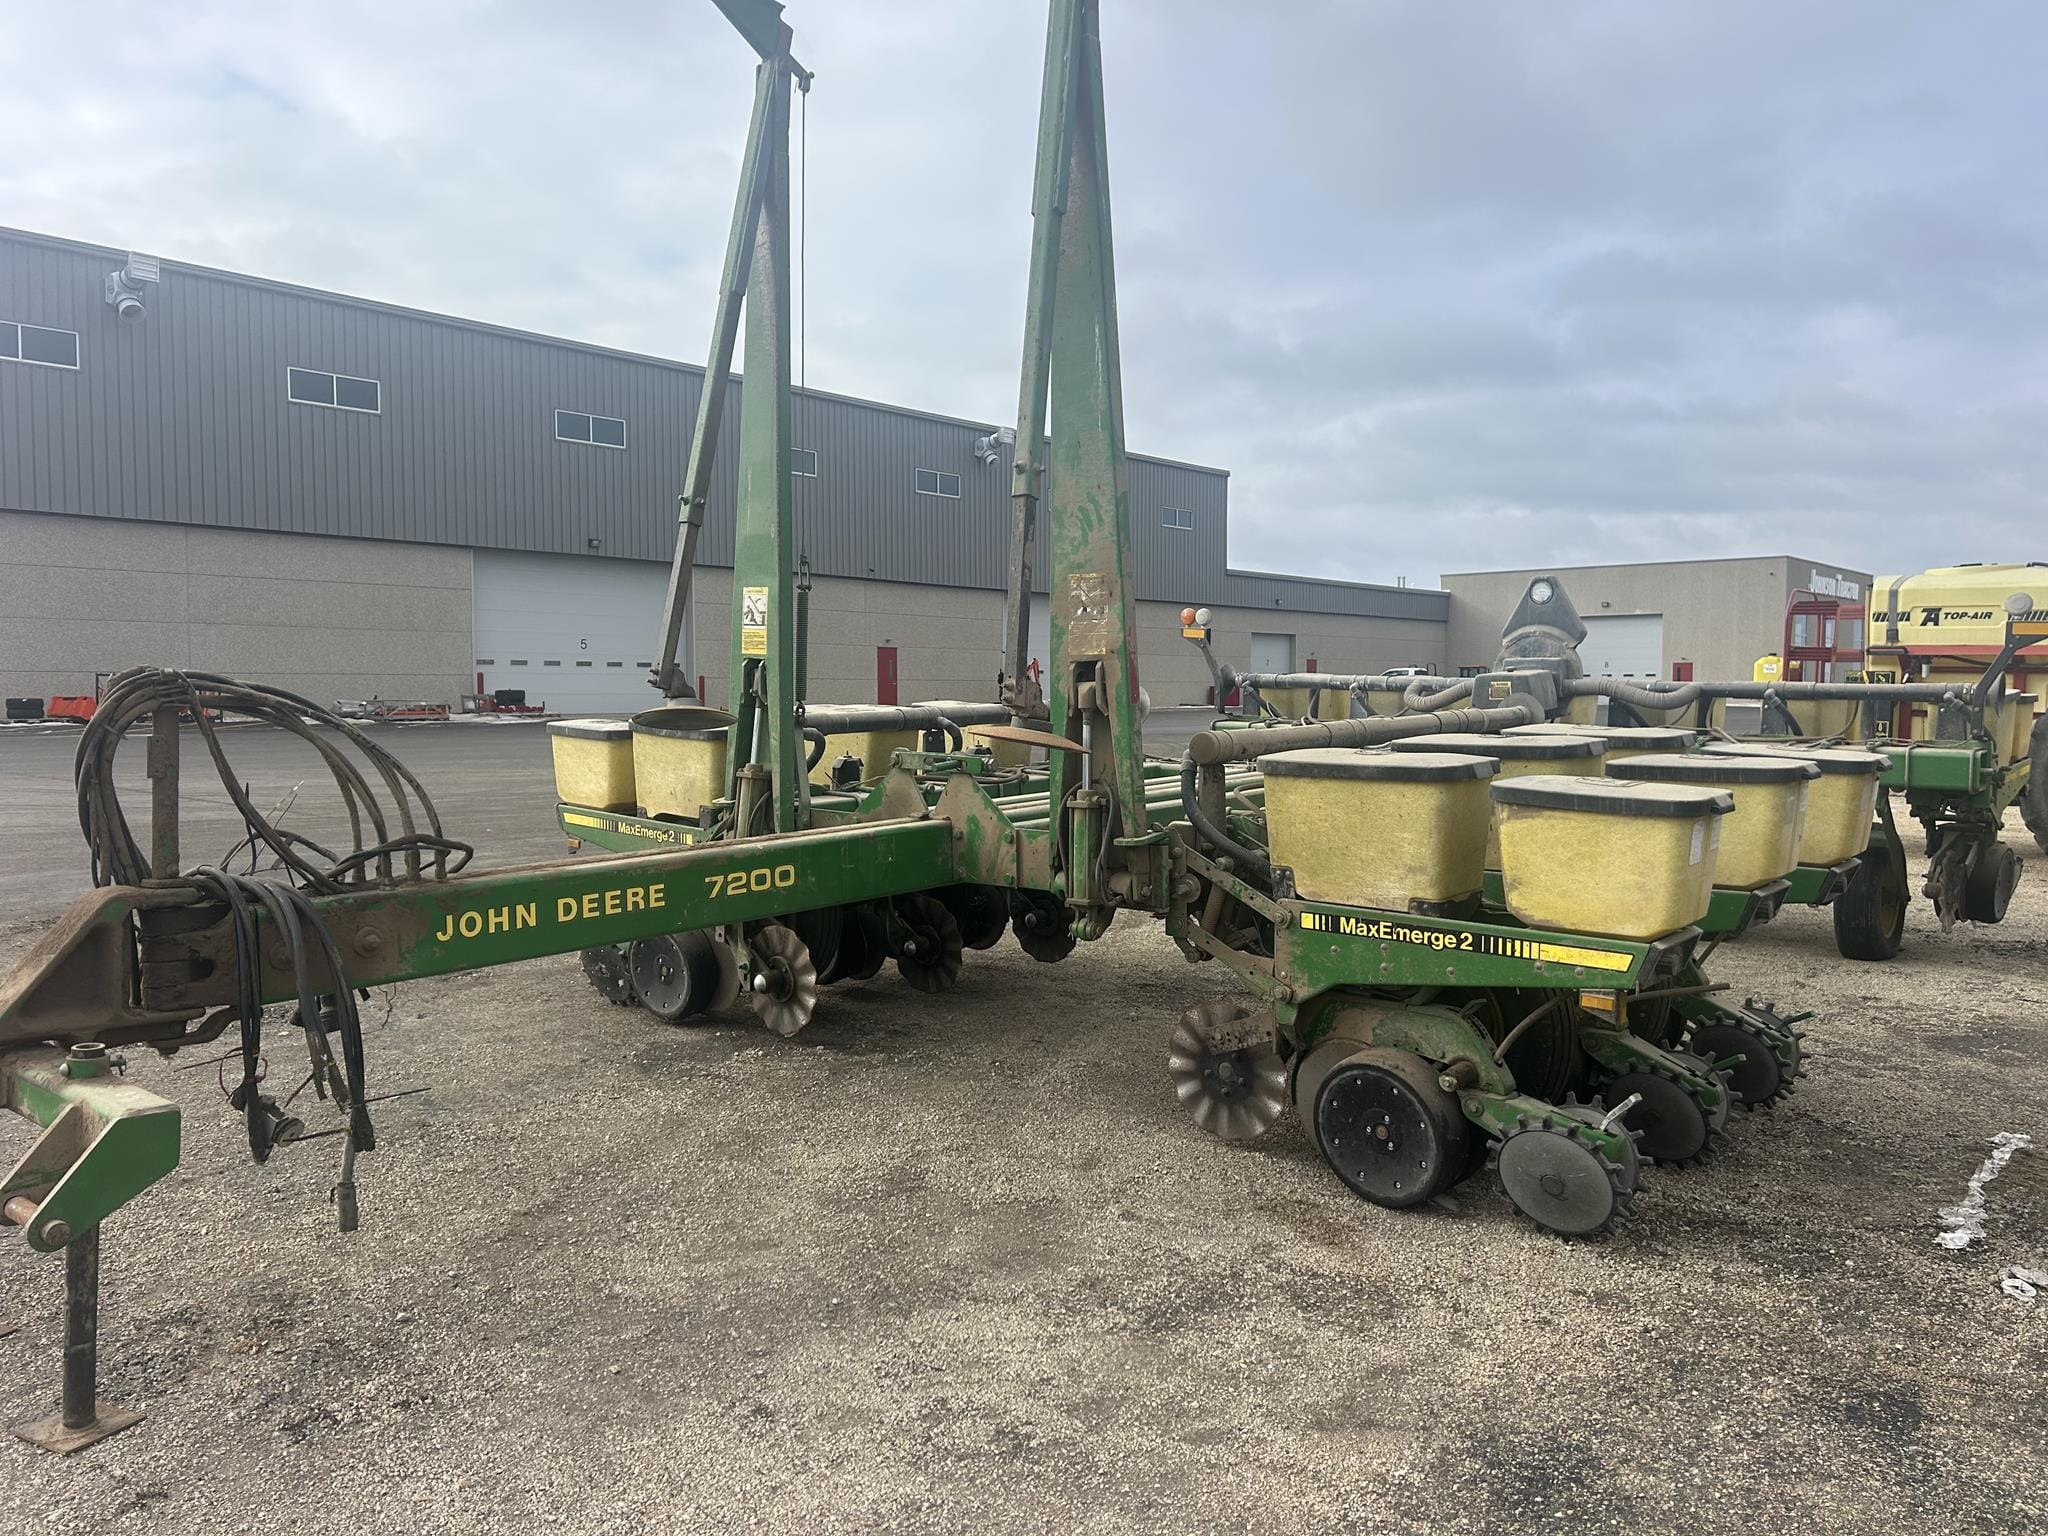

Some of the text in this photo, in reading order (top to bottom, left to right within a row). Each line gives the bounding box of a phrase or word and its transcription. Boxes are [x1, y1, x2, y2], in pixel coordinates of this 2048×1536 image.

[1943, 611, 1993, 620] TOP-AIR
[580, 638, 588, 650] 5
[436, 864, 796, 941] JOHN DEERE 7200
